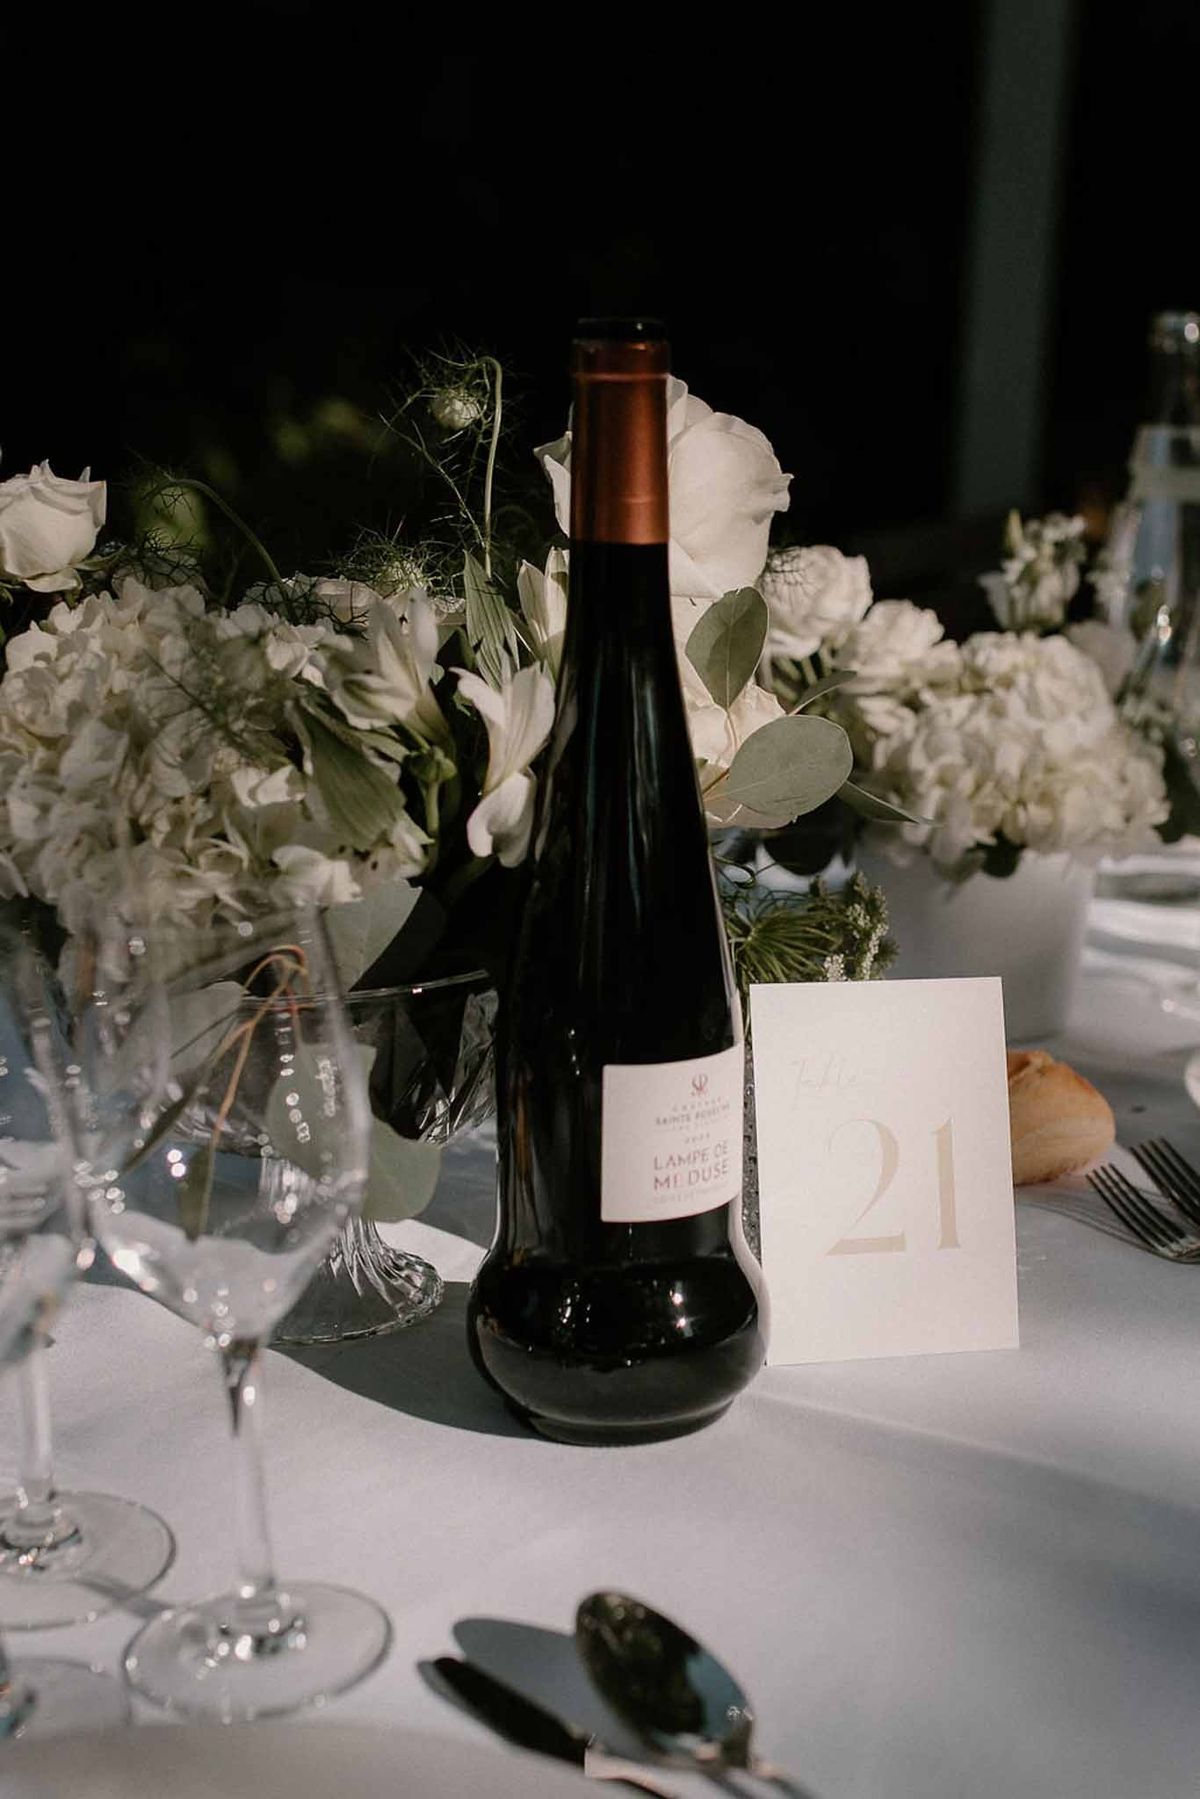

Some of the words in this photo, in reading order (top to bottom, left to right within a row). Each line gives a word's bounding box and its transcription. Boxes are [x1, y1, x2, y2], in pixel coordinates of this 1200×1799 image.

[653, 1146, 710, 1171] LAMPE
[714, 1139, 728, 1158] DE
[825, 1117, 961, 1256] 21
